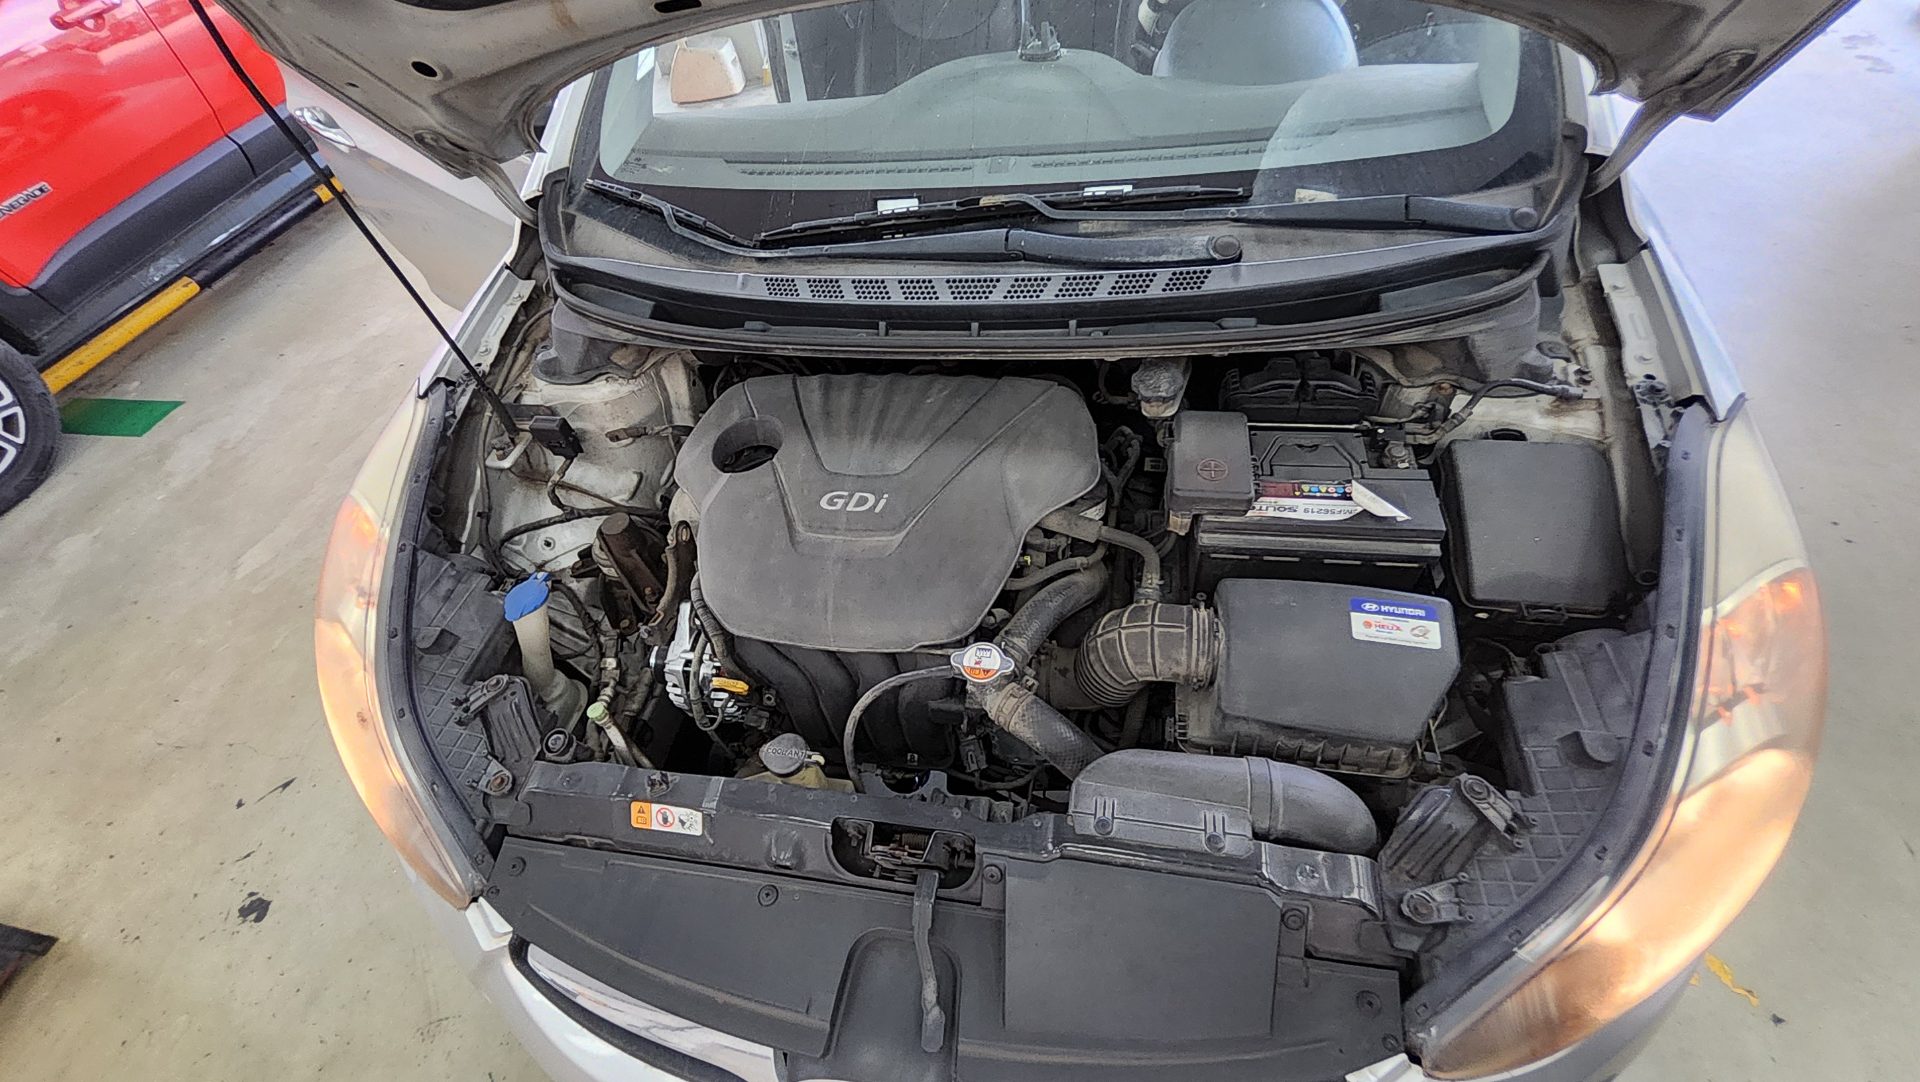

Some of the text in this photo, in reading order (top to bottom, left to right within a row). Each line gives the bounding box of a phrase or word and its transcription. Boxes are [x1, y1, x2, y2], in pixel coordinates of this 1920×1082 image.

[819, 490, 889, 514] GDi
[1380, 605, 1426, 617] HYUNDAI
[766, 747, 805, 758] COOLANT
